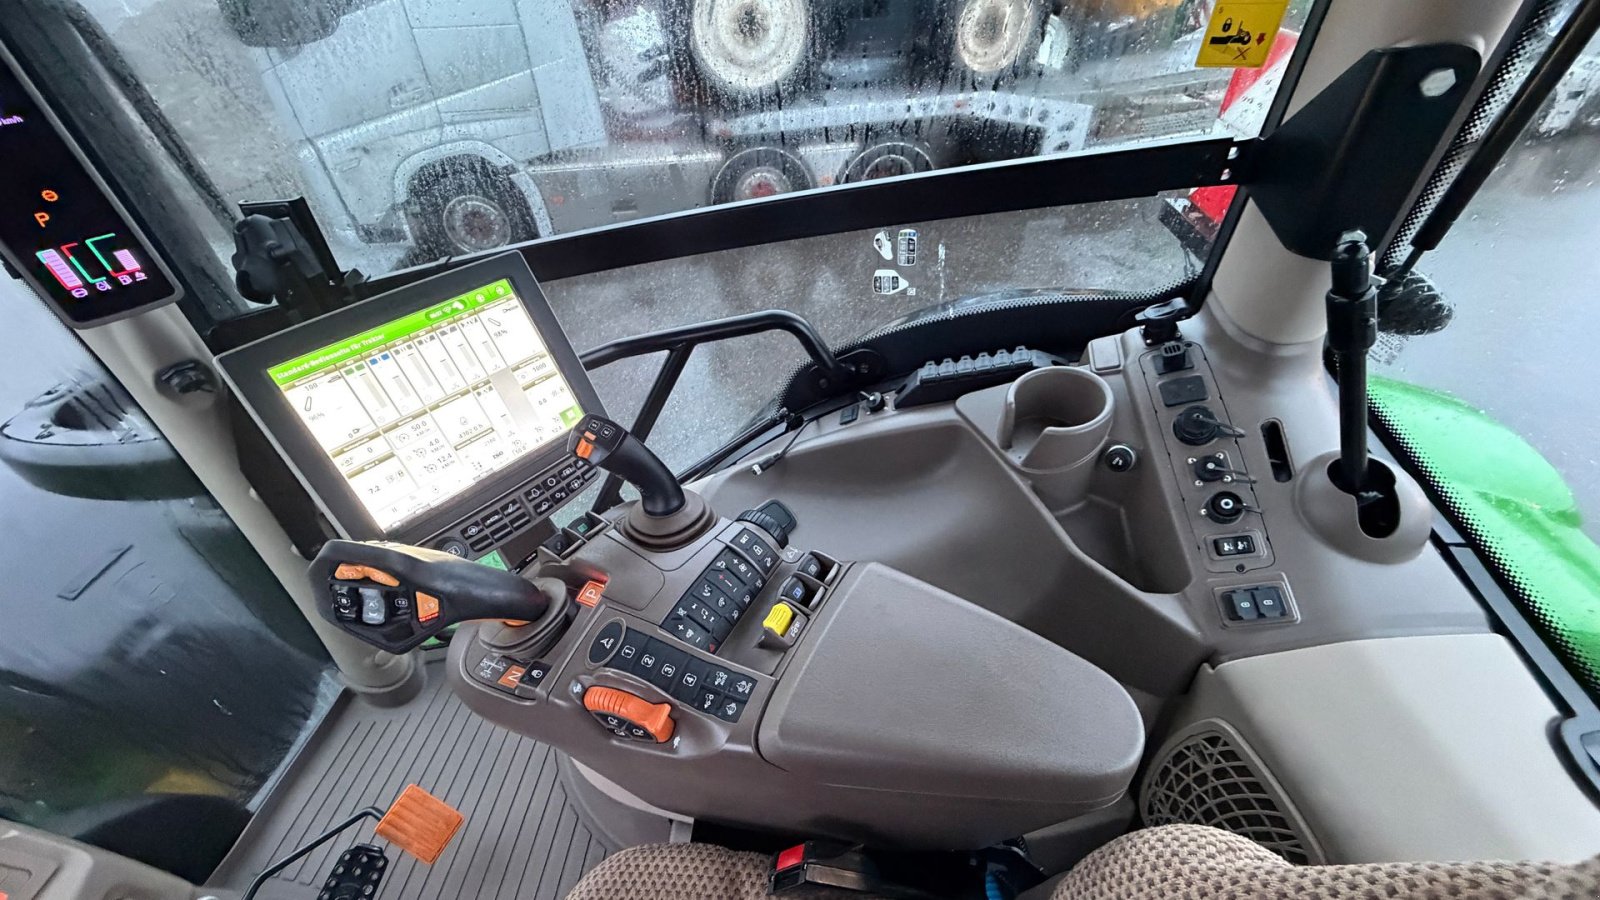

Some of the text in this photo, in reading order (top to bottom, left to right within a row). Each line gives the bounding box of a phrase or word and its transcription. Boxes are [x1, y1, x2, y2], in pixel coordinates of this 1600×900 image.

[34, 211, 50, 228] P
[304, 382, 318, 392] 100
[585, 587, 598, 600] P
[507, 670, 522, 682] N
[645, 657, 652, 665] 2
[664, 666, 673, 674] 3
[685, 675, 694, 684] 4
